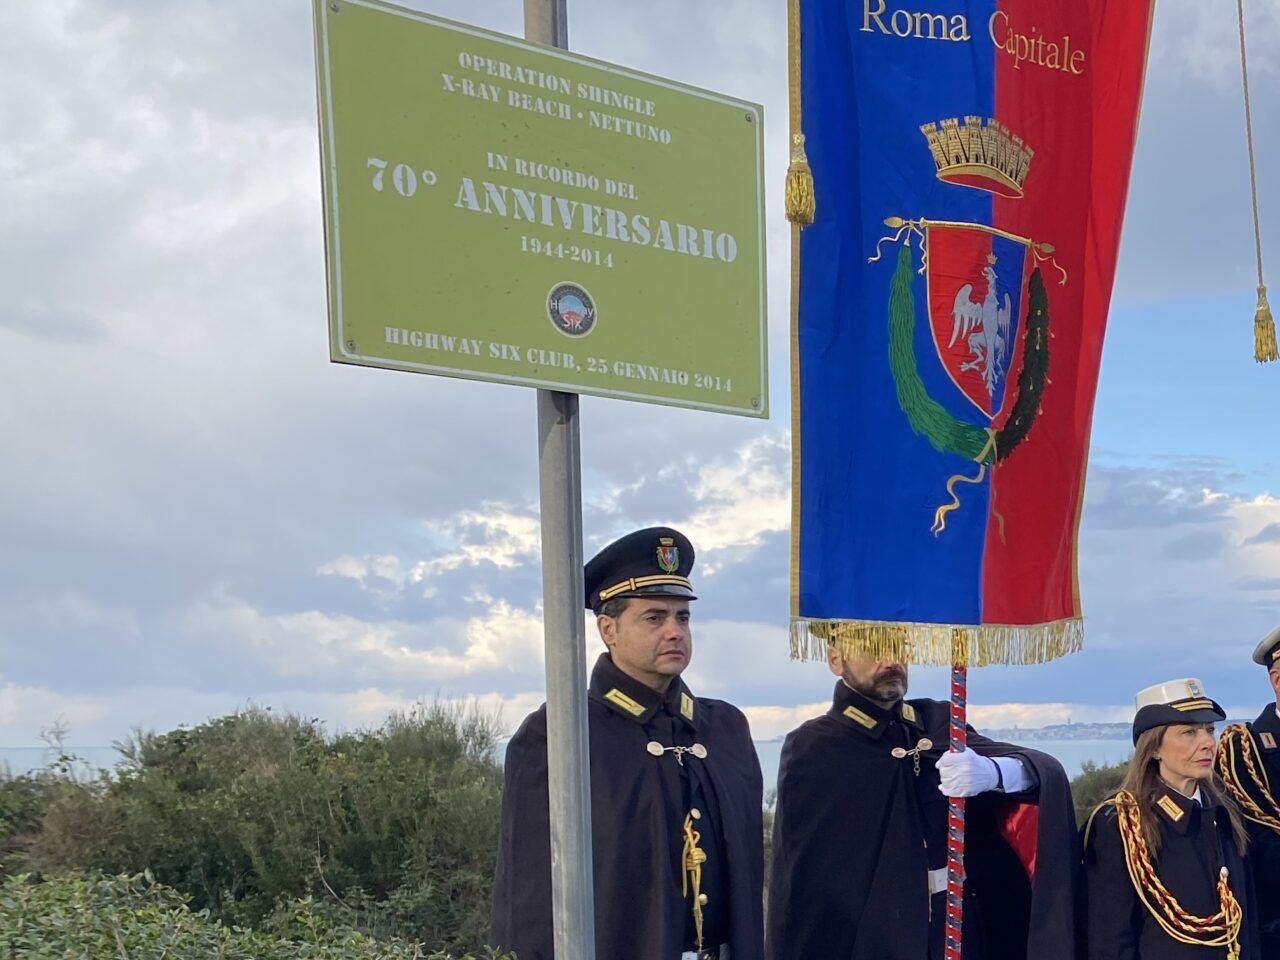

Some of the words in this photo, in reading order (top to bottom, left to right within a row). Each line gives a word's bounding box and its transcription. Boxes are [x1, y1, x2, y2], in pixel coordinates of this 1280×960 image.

[859, 0, 971, 41] Roma
[989, 10, 1085, 75] Capitale
[441, 73, 501, 102] X-RAY
[508, 90, 571, 120] BEACH
[589, 110, 671, 145] NETTUNO
[458, 51, 571, 95] OPERATION
[577, 82, 656, 117] SHINGLE
[487, 151, 508, 171] IN
[515, 158, 599, 191] RICORDO
[605, 179, 638, 201] DEL
[367, 157, 437, 197] 70°
[454, 177, 738, 263] ANNIVERSARIO
[520, 236, 613, 268] 1944-2014
[563, 314, 582, 329] Six
[384, 326, 484, 357] HIGHWAY
[489, 343, 521, 362] SIX
[527, 348, 581, 372] CLUB,
[587, 357, 608, 374] 25
[613, 361, 689, 386] GENNAIO
[694, 372, 733, 393] 2014
